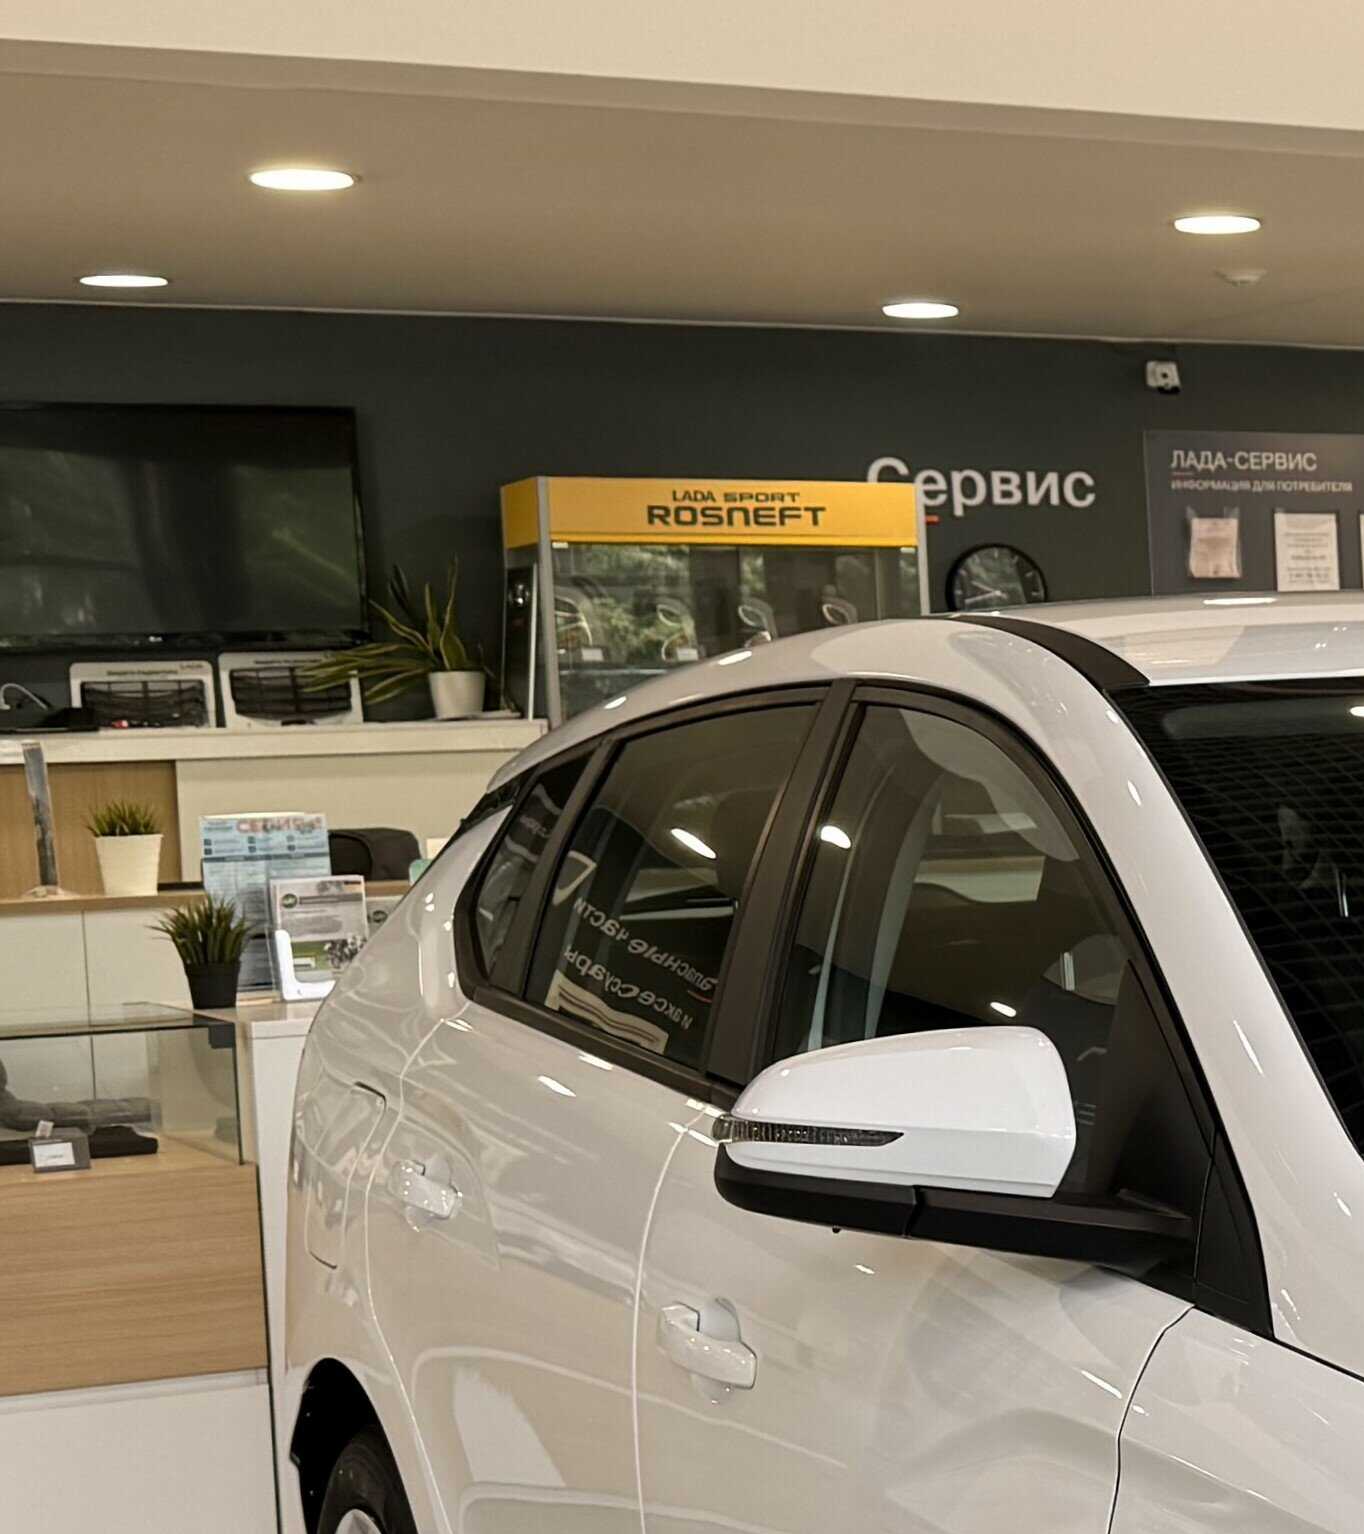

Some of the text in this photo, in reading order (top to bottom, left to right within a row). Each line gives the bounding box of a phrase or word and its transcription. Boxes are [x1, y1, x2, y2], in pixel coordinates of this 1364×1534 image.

[1170, 449, 1318, 473] ЛАДА-СЕРВИС
[672, 490, 801, 503] LADA SPORT
[647, 504, 827, 528] ROSNEFT
